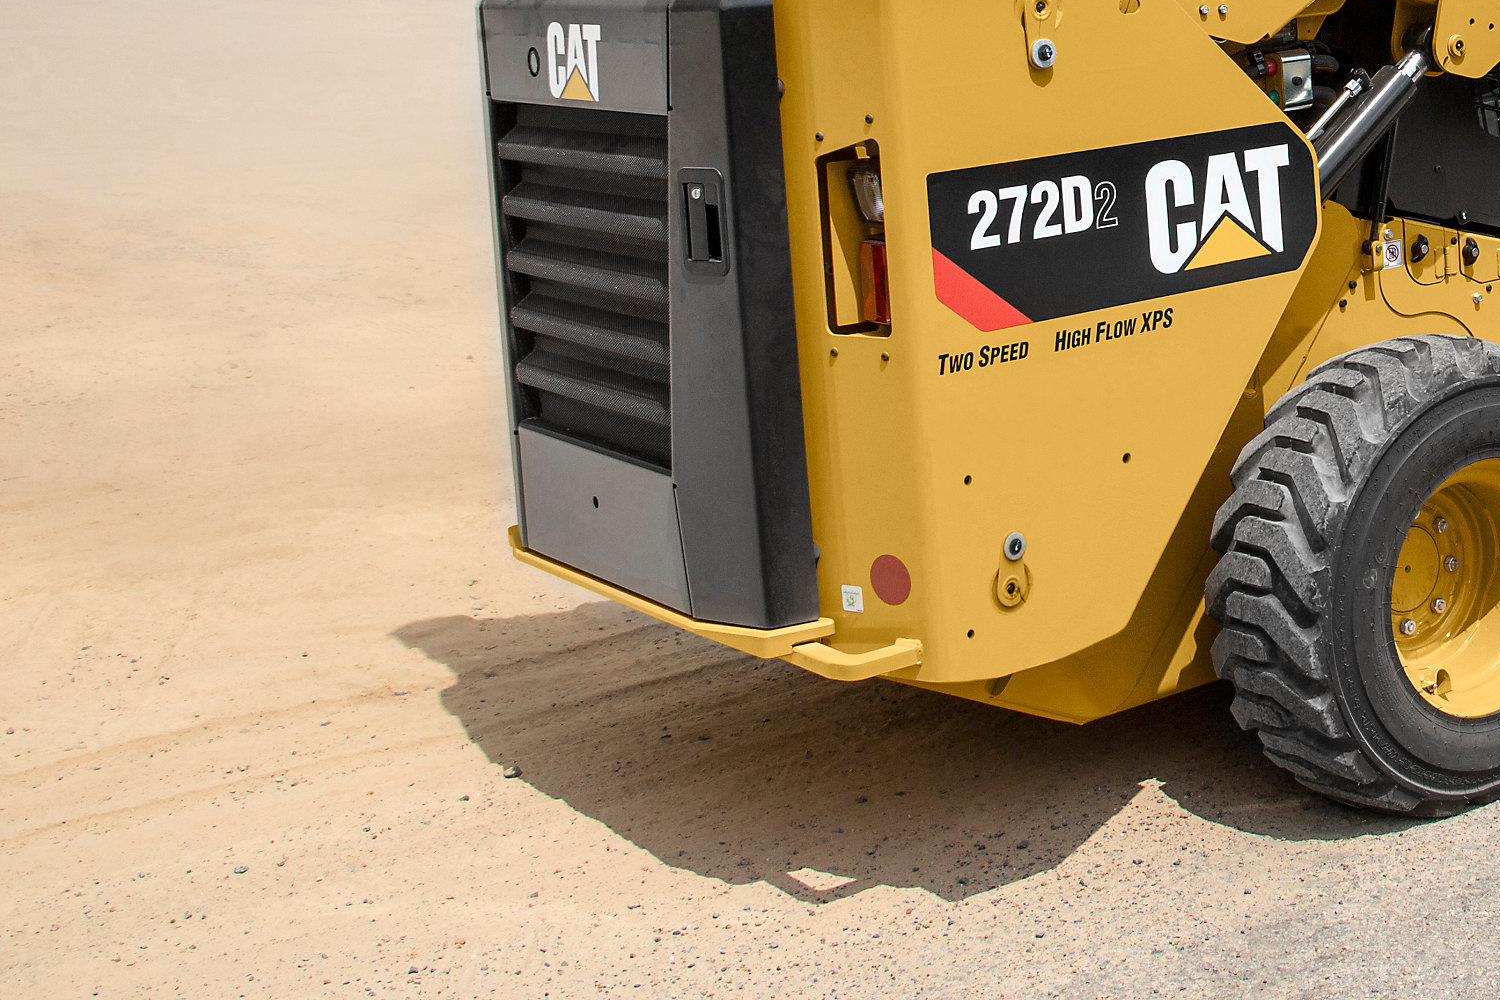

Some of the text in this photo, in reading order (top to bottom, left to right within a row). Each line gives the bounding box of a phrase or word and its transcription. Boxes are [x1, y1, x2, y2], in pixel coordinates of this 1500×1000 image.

[547, 21, 601, 102] CAT
[967, 143, 1290, 275] 272D2 CAT
[1140, 307, 1174, 333] XPS
